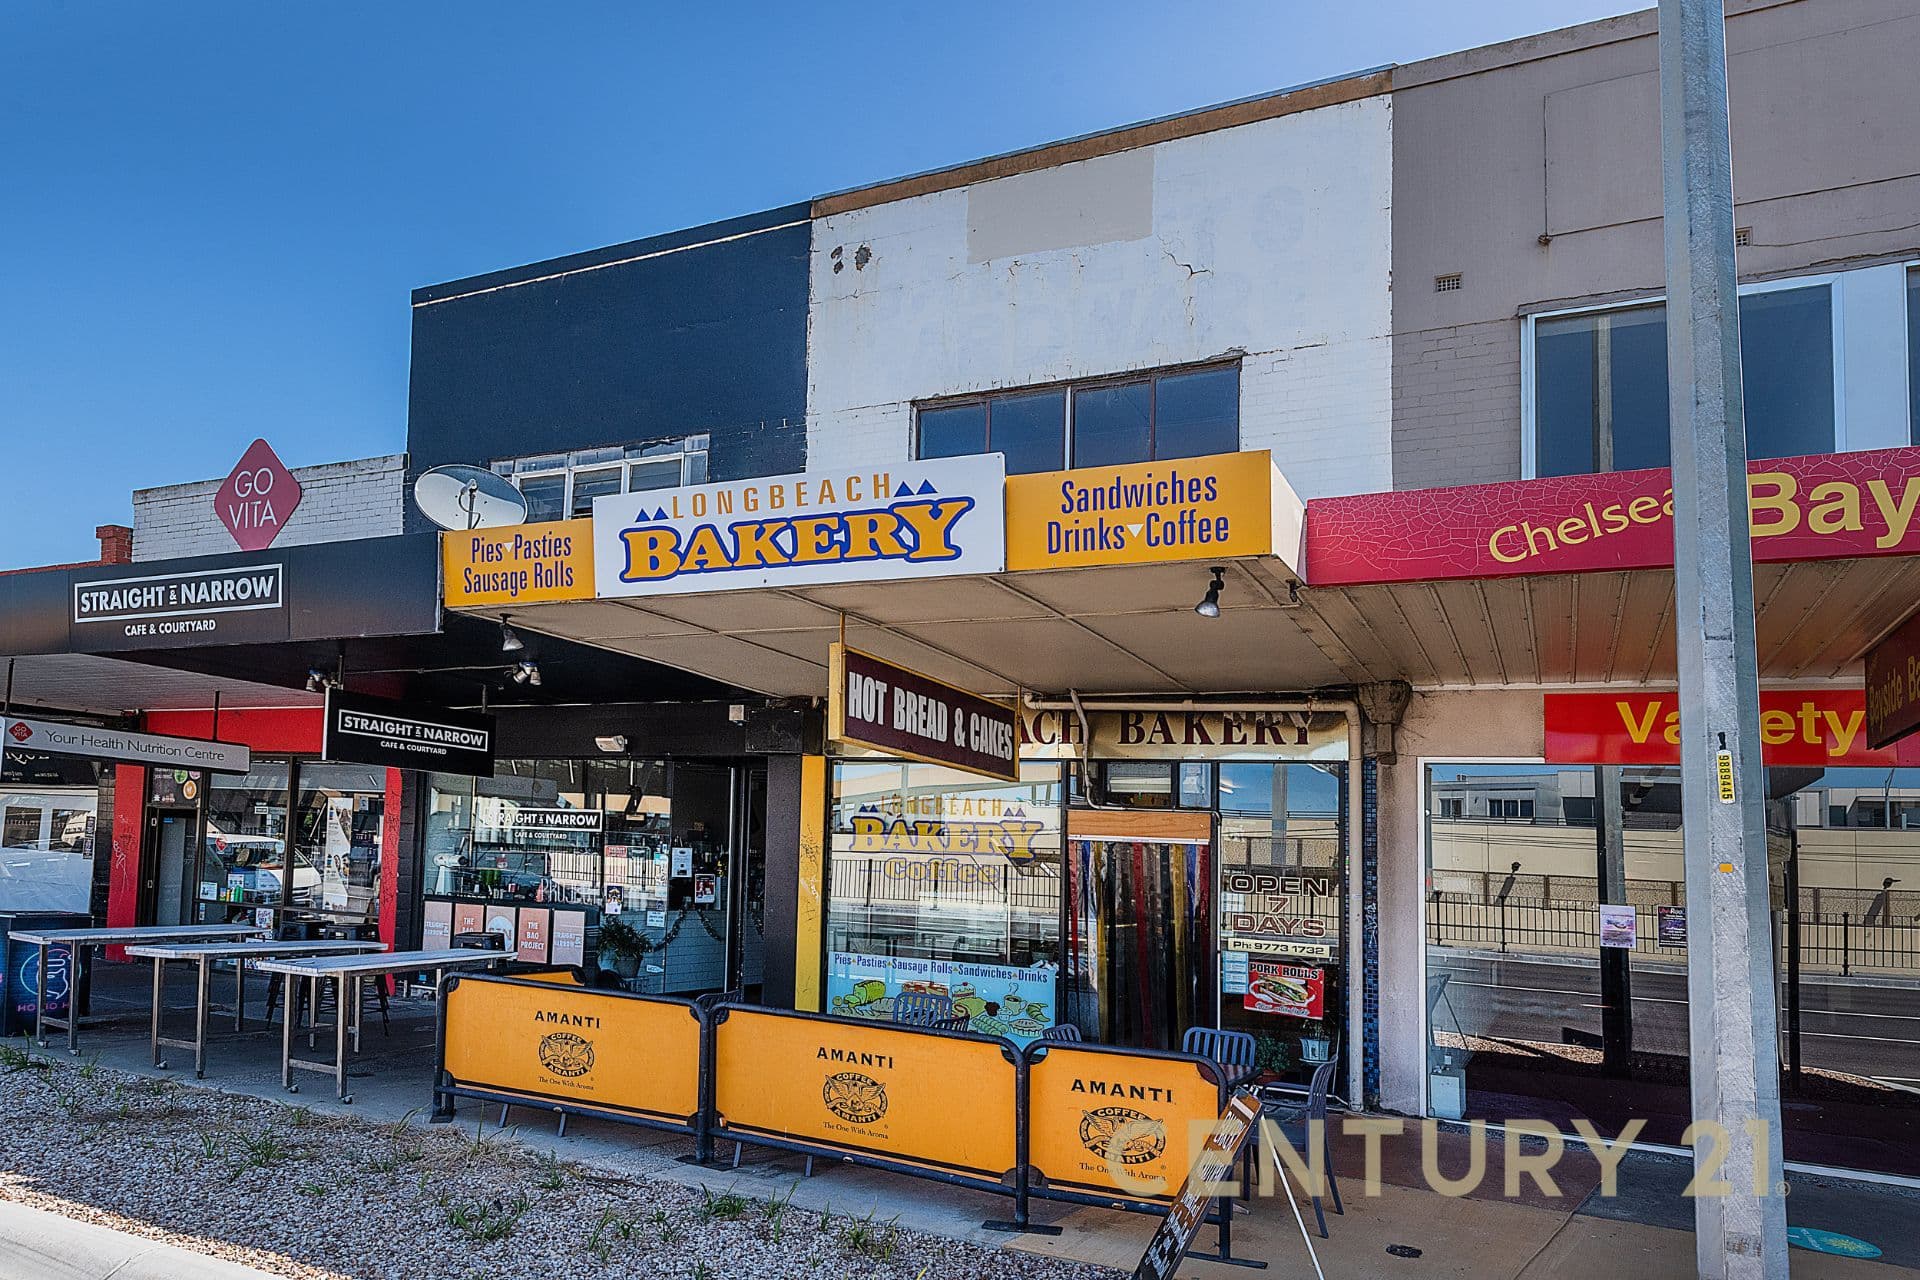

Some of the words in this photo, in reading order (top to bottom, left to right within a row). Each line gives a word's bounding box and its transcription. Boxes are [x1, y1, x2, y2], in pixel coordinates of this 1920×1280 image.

[235, 467, 274, 498] GO
[1061, 470, 1217, 514] Sandwiches
[671, 473, 891, 519] LONGBEACH
[228, 499, 278, 529] VITA
[619, 496, 975, 583] BAKERY
[1047, 518, 1125, 554] Drinks
[1146, 509, 1229, 547] Coffee
[471, 537, 503, 563] Pies
[514, 531, 572, 560] Pasties
[464, 567, 527, 597] Sausage
[534, 560, 573, 588] Rolls
[81, 586, 165, 613] STRAIGHT
[169, 586, 178, 603] &
[182, 575, 274, 604] NARROW
[125, 624, 147, 636] CAFE
[150, 624, 156, 635] &
[159, 620, 216, 634] COURTYARD
[848, 671, 887, 725] HOT
[893, 687, 948, 742] BREAD
[954, 707, 966, 748] &
[970, 713, 1013, 761] CAKES
[1118, 711, 1314, 745] BAKERY
[344, 716, 413, 737] STRAIGHT
[424, 727, 484, 746] NARROW
[1616, 702, 1866, 756] Vety
[45, 730, 78, 745] Your
[81, 735, 124, 750] Health
[128, 740, 181, 756] Nutrition
[185, 747, 225, 761] Centre
[380, 740, 398, 749] CAFE
[407, 744, 447, 755] COURTYARD
[1719, 755, 1733, 799] 9889445
[881, 795, 1002, 817] LONGBEACH
[545, 814, 598, 826] NARROW
[849, 816, 1044, 866] BAKERY
[884, 857, 1000, 885] Coffee
[1230, 874, 1328, 897] OPEN
[1266, 895, 1290, 914] 7
[464, 917, 475, 925] THE
[527, 921, 539, 930] THE
[1232, 913, 1325, 937] DAYS
[520, 941, 545, 950] PROJECT
[1233, 941, 1251, 950] Ph:
[1254, 942, 1289, 951] 9773
[1292, 945, 1325, 954] 1732
[834, 954, 852, 965] Pies
[856, 955, 887, 968] Pasties
[891, 958, 928, 974] Sausage
[931, 961, 953, 974] Rolls
[958, 964, 1013, 980] Sandwiches
[1018, 969, 1048, 983] Drinks
[1249, 963, 1280, 975] PORK
[1282, 967, 1319, 979] ROLLS
[534, 1010, 600, 1029] AMANTI
[550, 1033, 583, 1043] COFFEE
[816, 1047, 893, 1069] AMANTI
[836, 1073, 873, 1086] COFFEE
[1070, 1079, 1172, 1103] AMANTI
[834, 1108, 876, 1123] AMANTI
[1097, 1108, 1147, 1121] COFFEE
[823, 1121, 835, 1130] The
[850, 1127, 866, 1136] With
[1079, 1162, 1095, 1171] The
[1096, 1165, 1113, 1174] On
